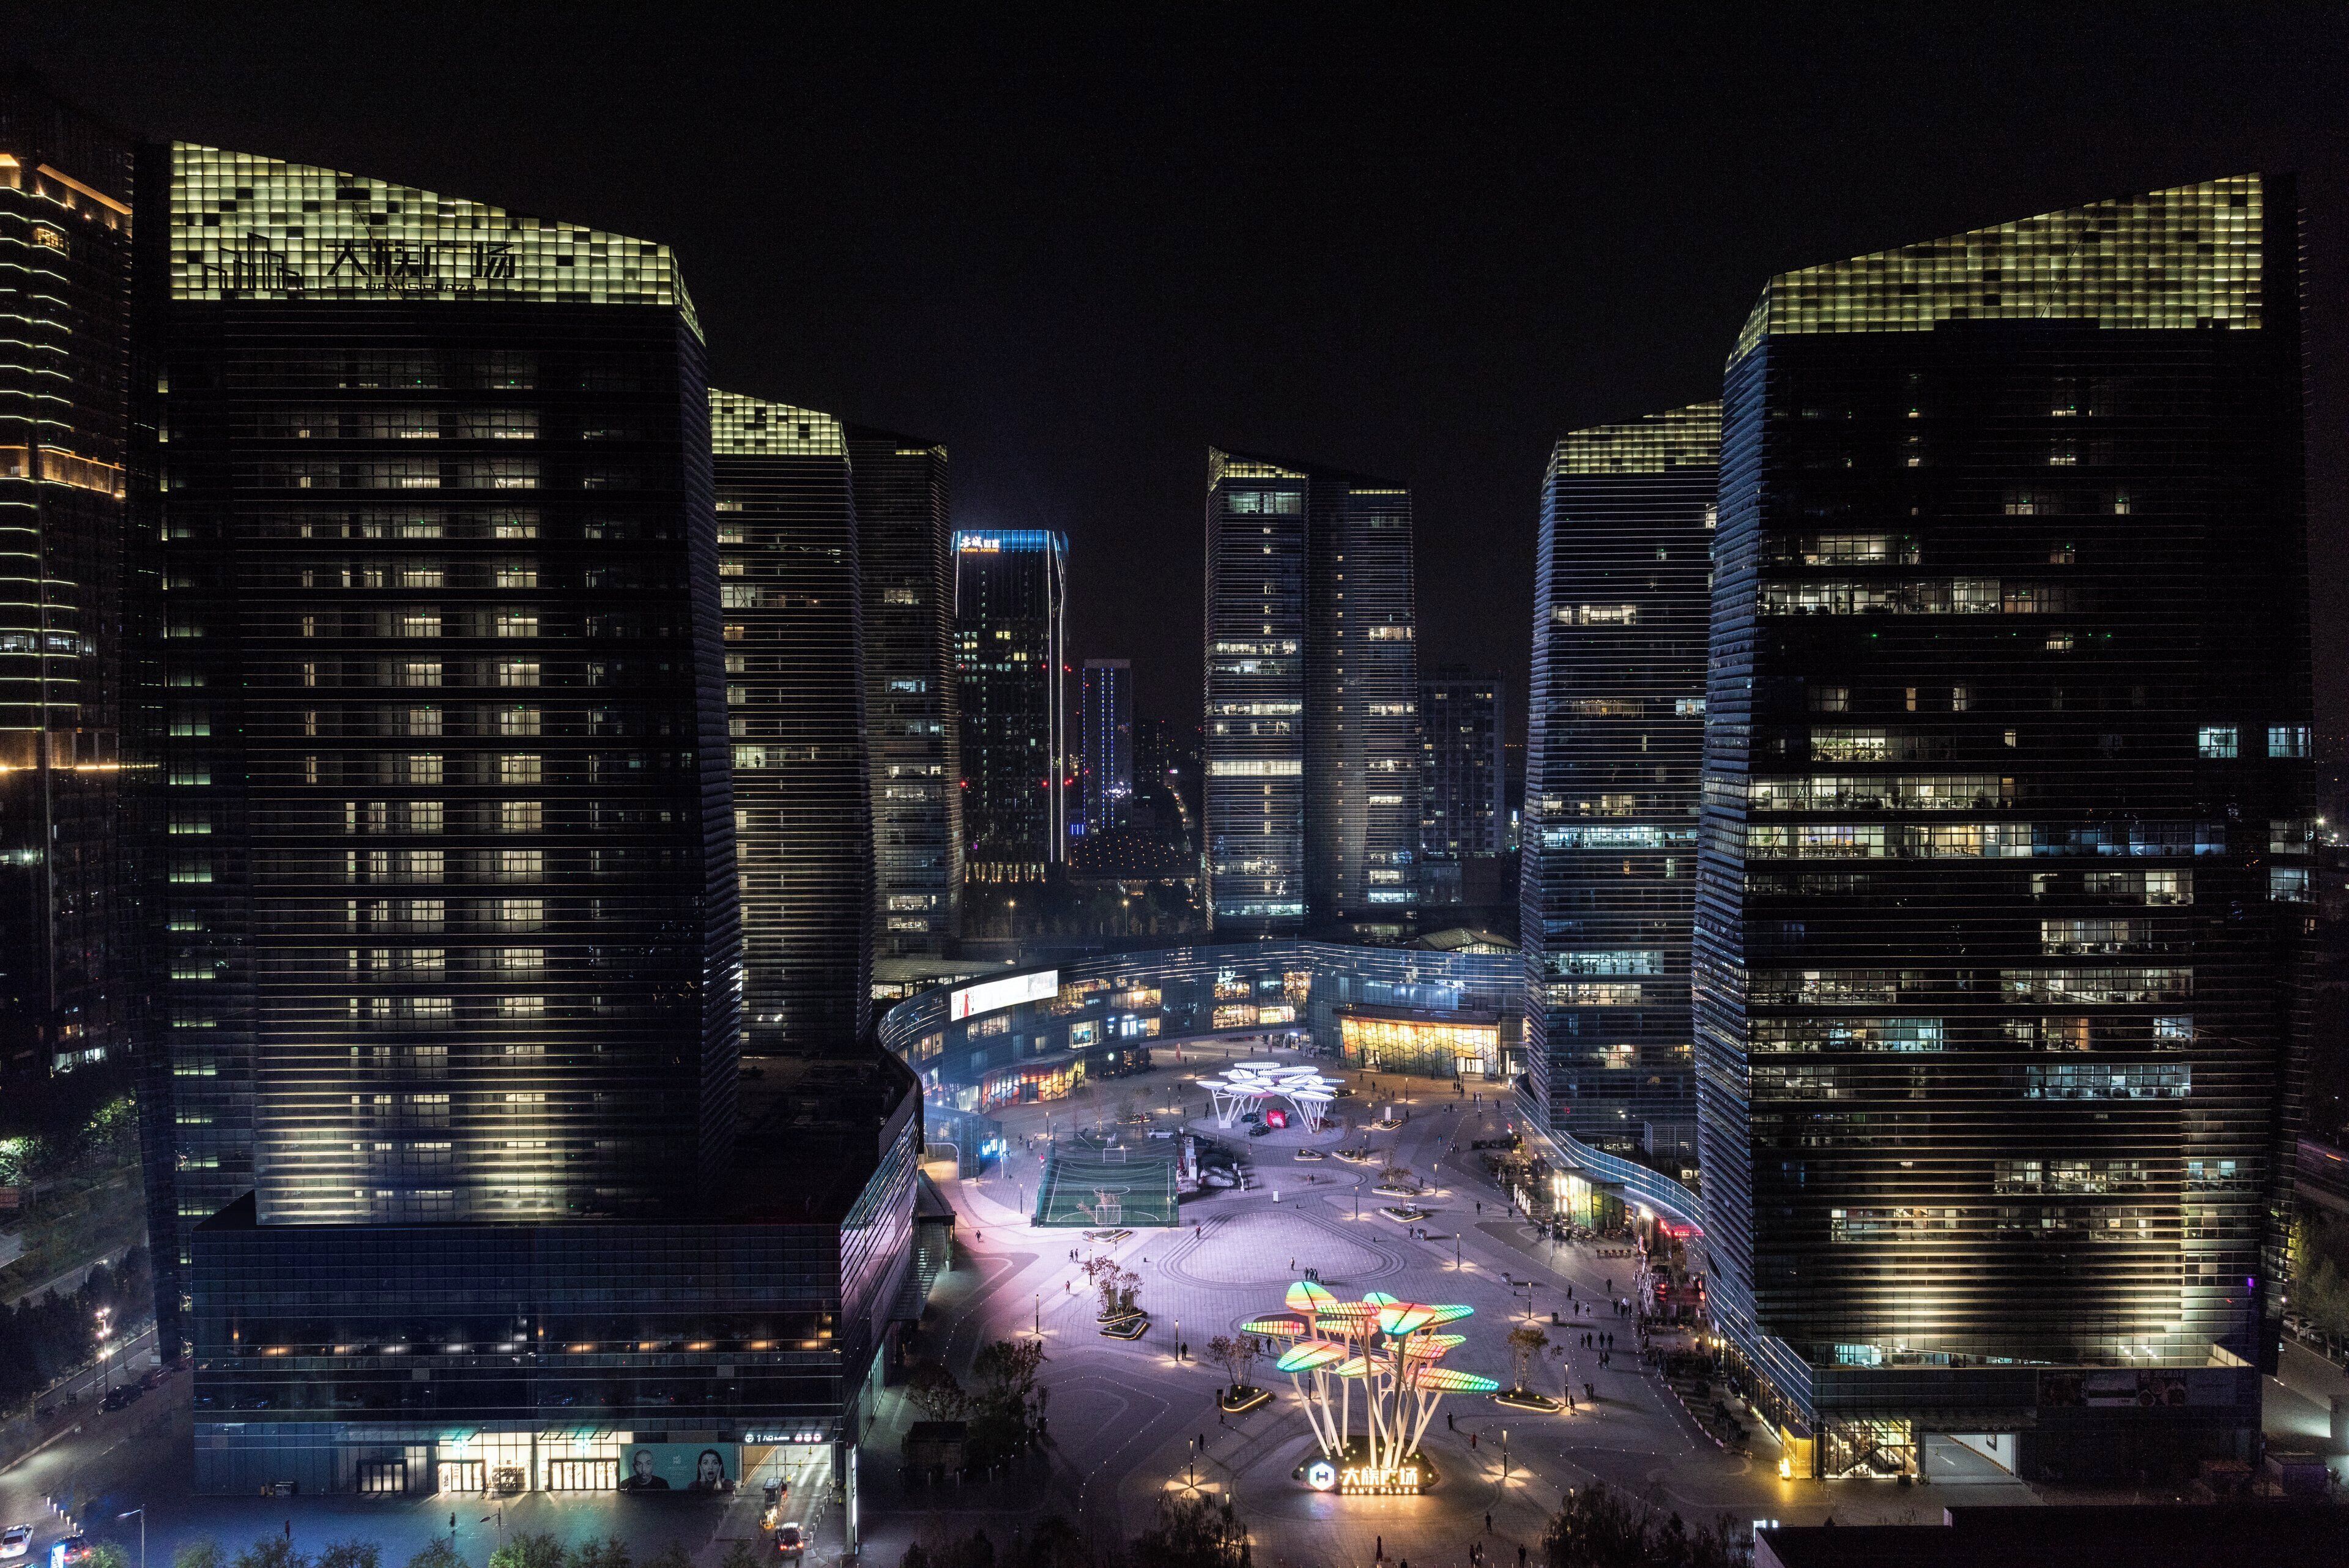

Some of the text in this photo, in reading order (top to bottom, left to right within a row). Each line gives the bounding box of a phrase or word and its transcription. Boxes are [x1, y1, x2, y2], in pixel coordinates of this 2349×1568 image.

[325, 239, 515, 278] 大族广场
[366, 283, 478, 294] HAN'S PLAZA
[1341, 1467, 1418, 1486] 大族广场
